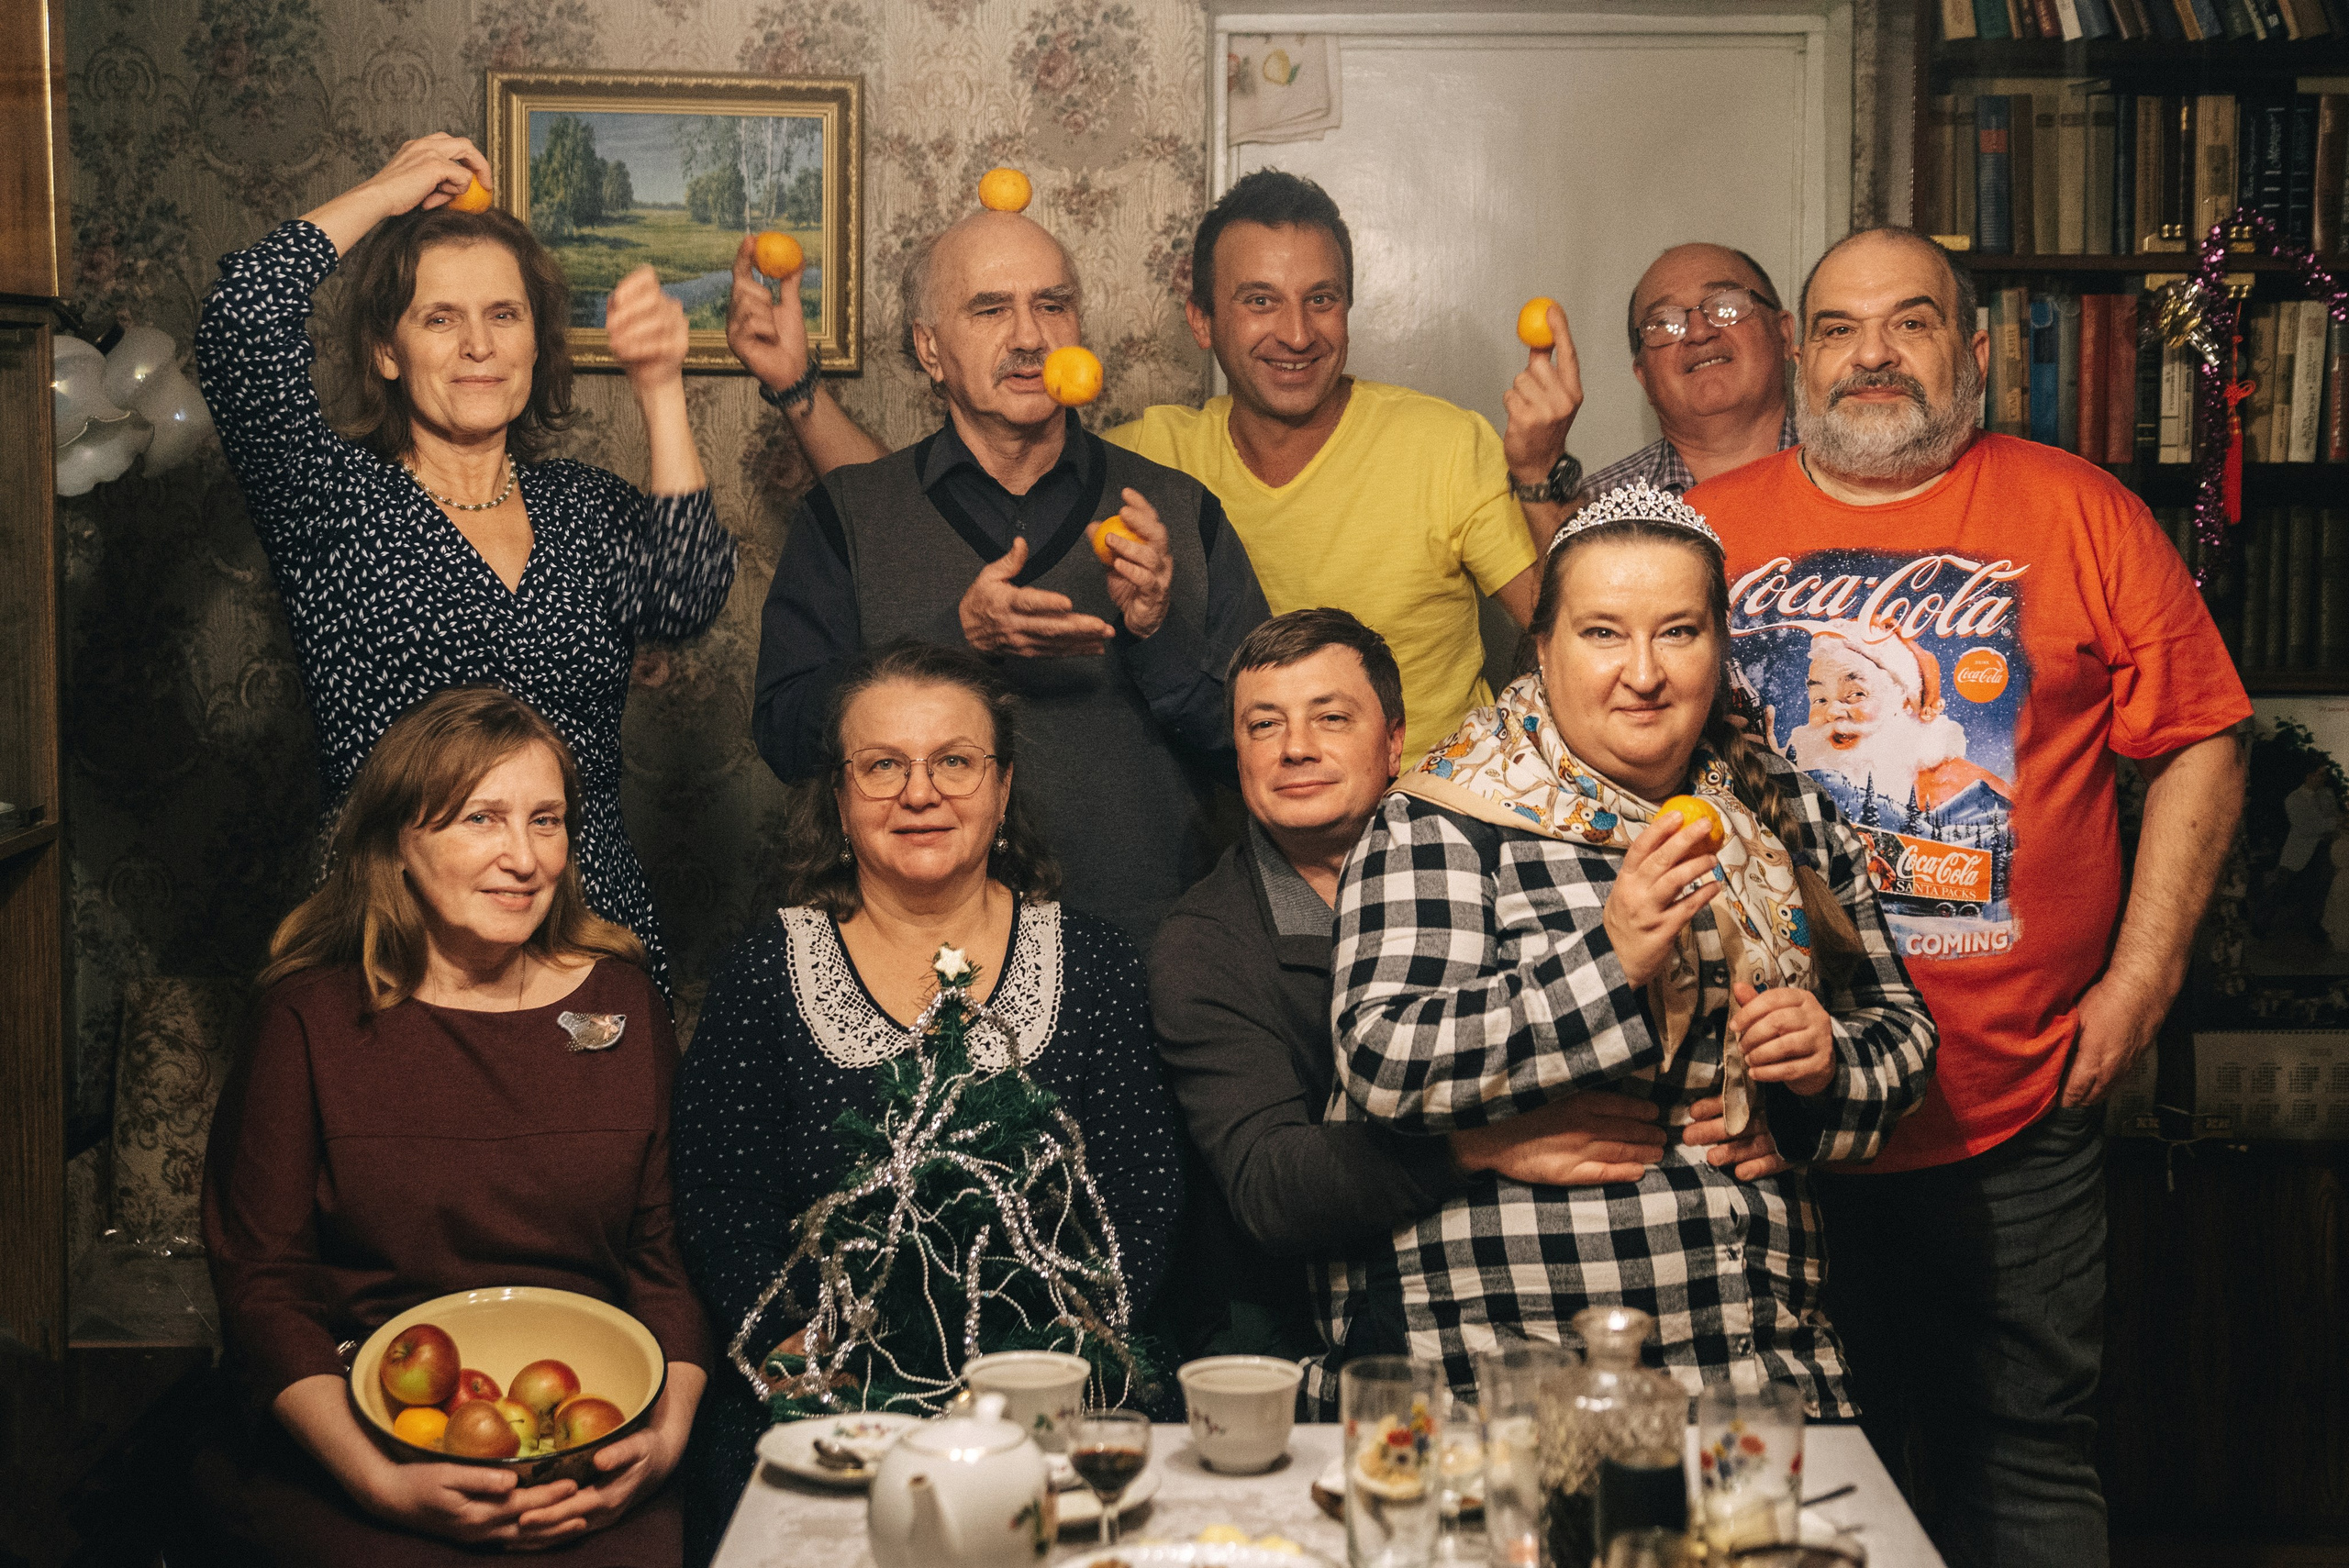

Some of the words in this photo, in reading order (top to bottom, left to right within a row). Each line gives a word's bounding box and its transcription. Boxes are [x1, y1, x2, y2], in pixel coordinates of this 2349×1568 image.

[1729, 554, 2031, 643] Coca-Cola
[1896, 845, 1983, 885] Coca-Cola
[1897, 881, 1938, 895] SANTA
[1942, 886, 1976, 899] PACKS
[1905, 929, 2009, 955] COMING
